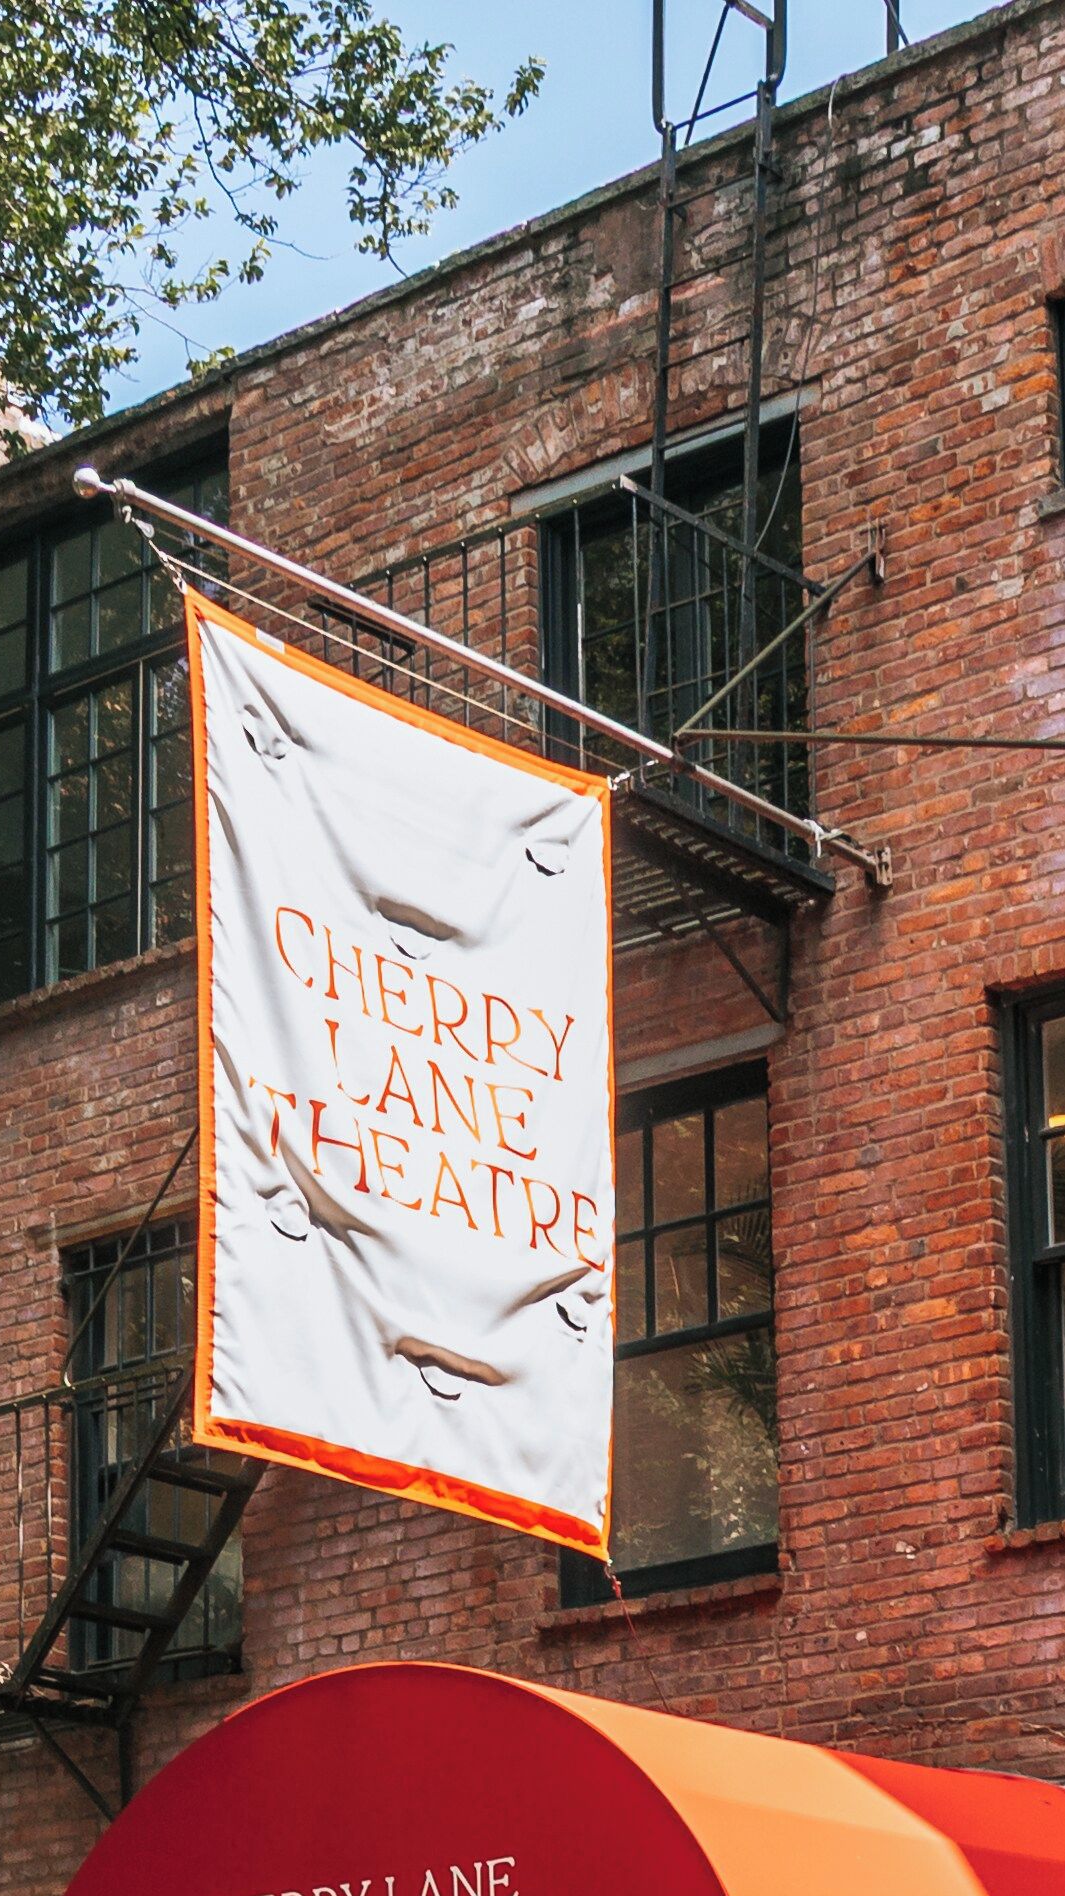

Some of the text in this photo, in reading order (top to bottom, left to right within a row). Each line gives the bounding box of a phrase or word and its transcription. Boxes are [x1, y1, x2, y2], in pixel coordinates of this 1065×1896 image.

[275, 906, 575, 1082] CHERRY
[248, 1075, 606, 1273] THEATRE
[325, 1018, 537, 1161] LANE
